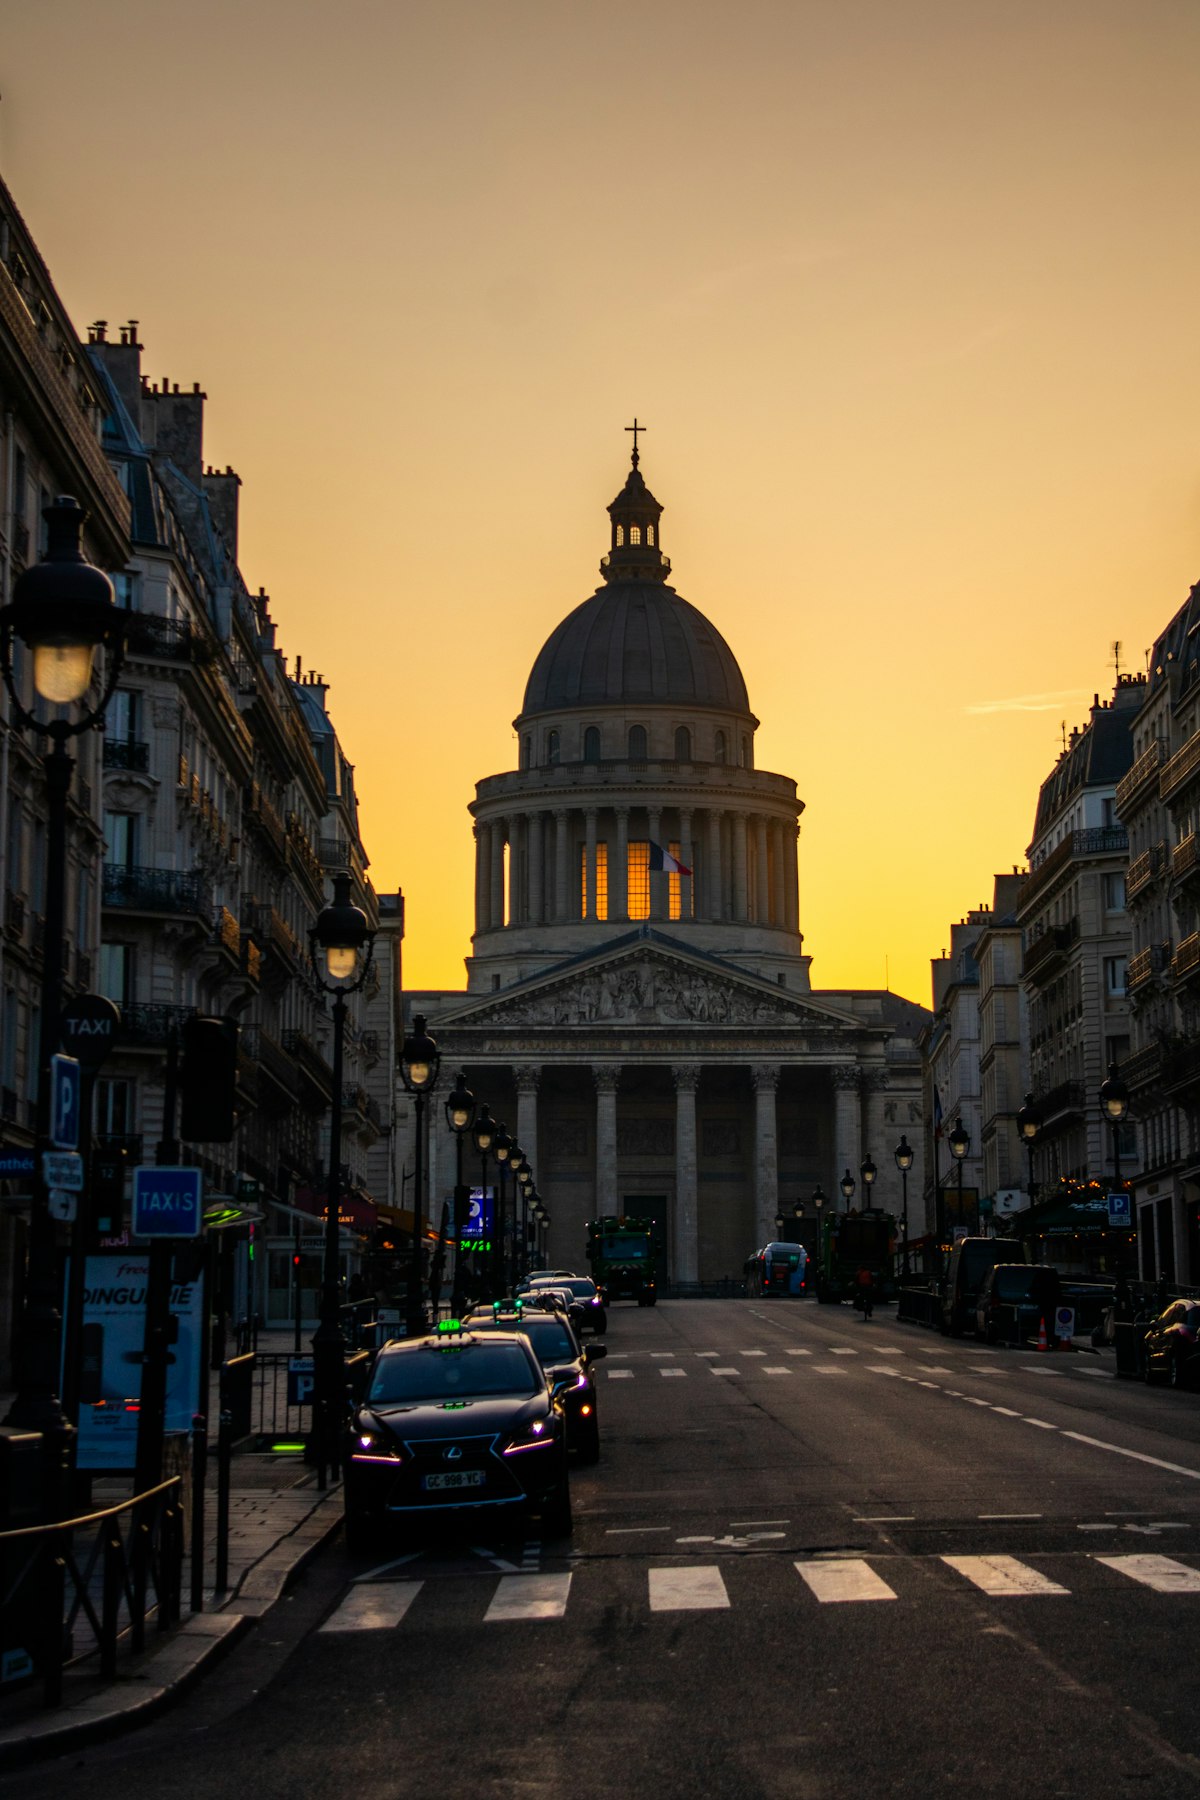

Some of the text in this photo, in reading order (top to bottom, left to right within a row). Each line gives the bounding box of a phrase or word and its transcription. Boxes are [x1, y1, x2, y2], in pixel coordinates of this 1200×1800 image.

[66, 1018, 111, 1035] TAXI
[140, 1191, 194, 1212] TAXIS
[1113, 1198, 1124, 1213] P
[82, 1287, 193, 1305] DINGUIE
[297, 1375, 315, 1401] P
